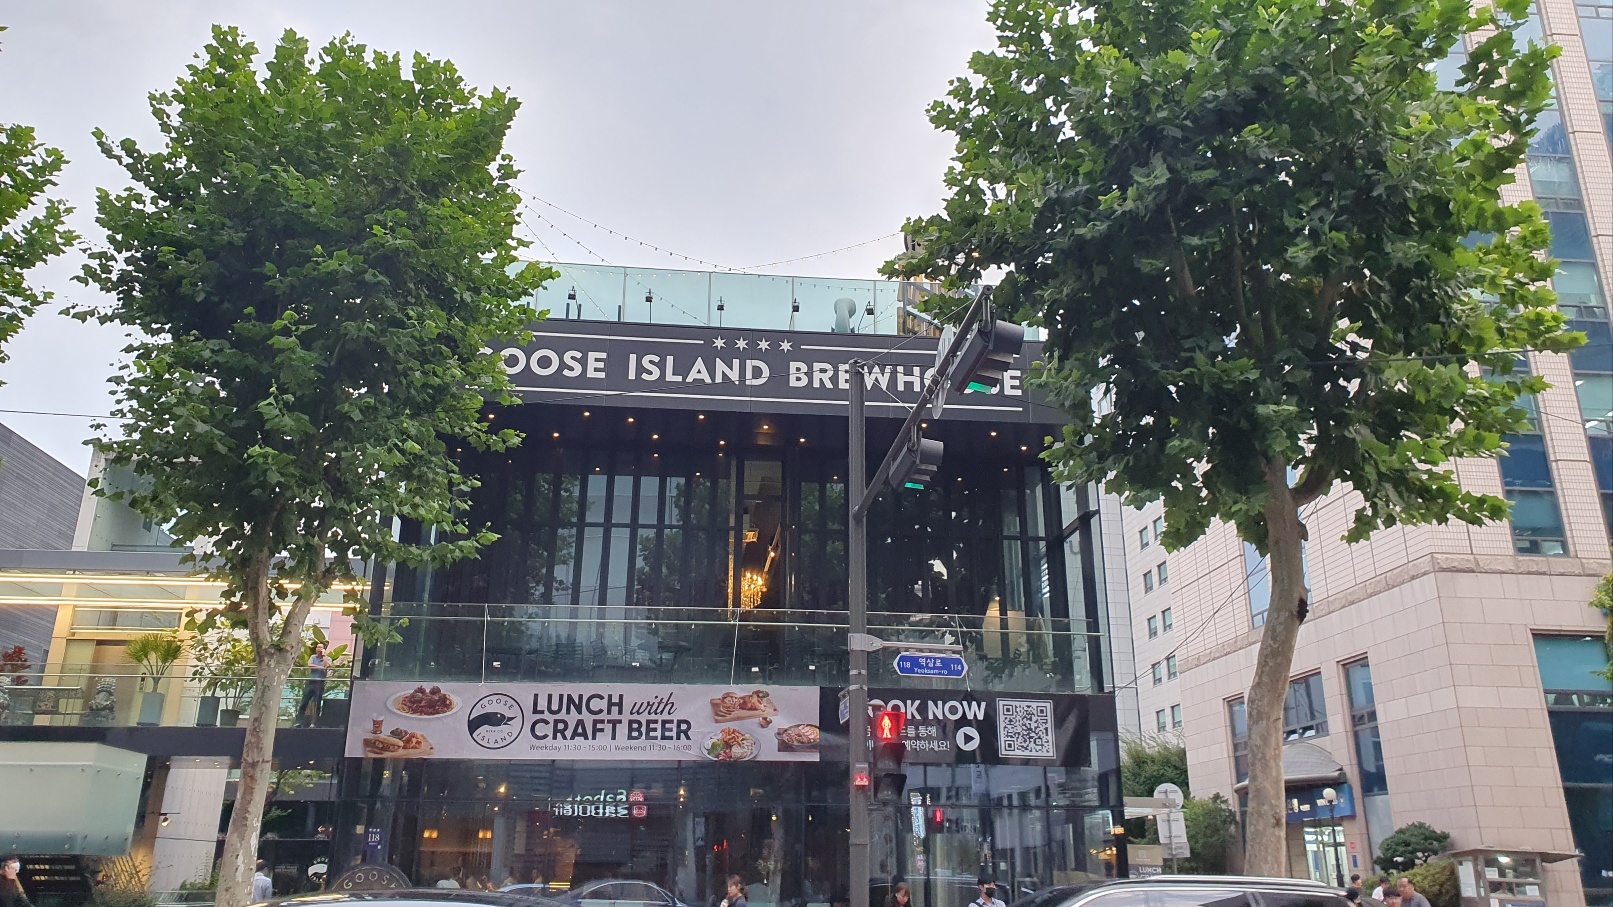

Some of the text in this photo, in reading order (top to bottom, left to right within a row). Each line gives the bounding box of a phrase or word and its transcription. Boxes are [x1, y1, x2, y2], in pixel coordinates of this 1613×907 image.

[477, 346, 1023, 396] OOSE ISLAND BREWHE
[918, 657, 943, 668] 역삼로
[914, 667, 948, 675] Yeoksam-ro
[480, 698, 514, 710] GOOSE
[532, 691, 678, 716] LUNCH with
[927, 700, 987, 721] NOW
[529, 718, 692, 741] CRAFT BEER
[917, 725, 937, 737] 통해
[476, 731, 513, 745] ISLAND
[529, 744, 561, 752] Weekday
[368, 833, 380, 842] 118
[1138, 866, 1162, 874] LUNCH
